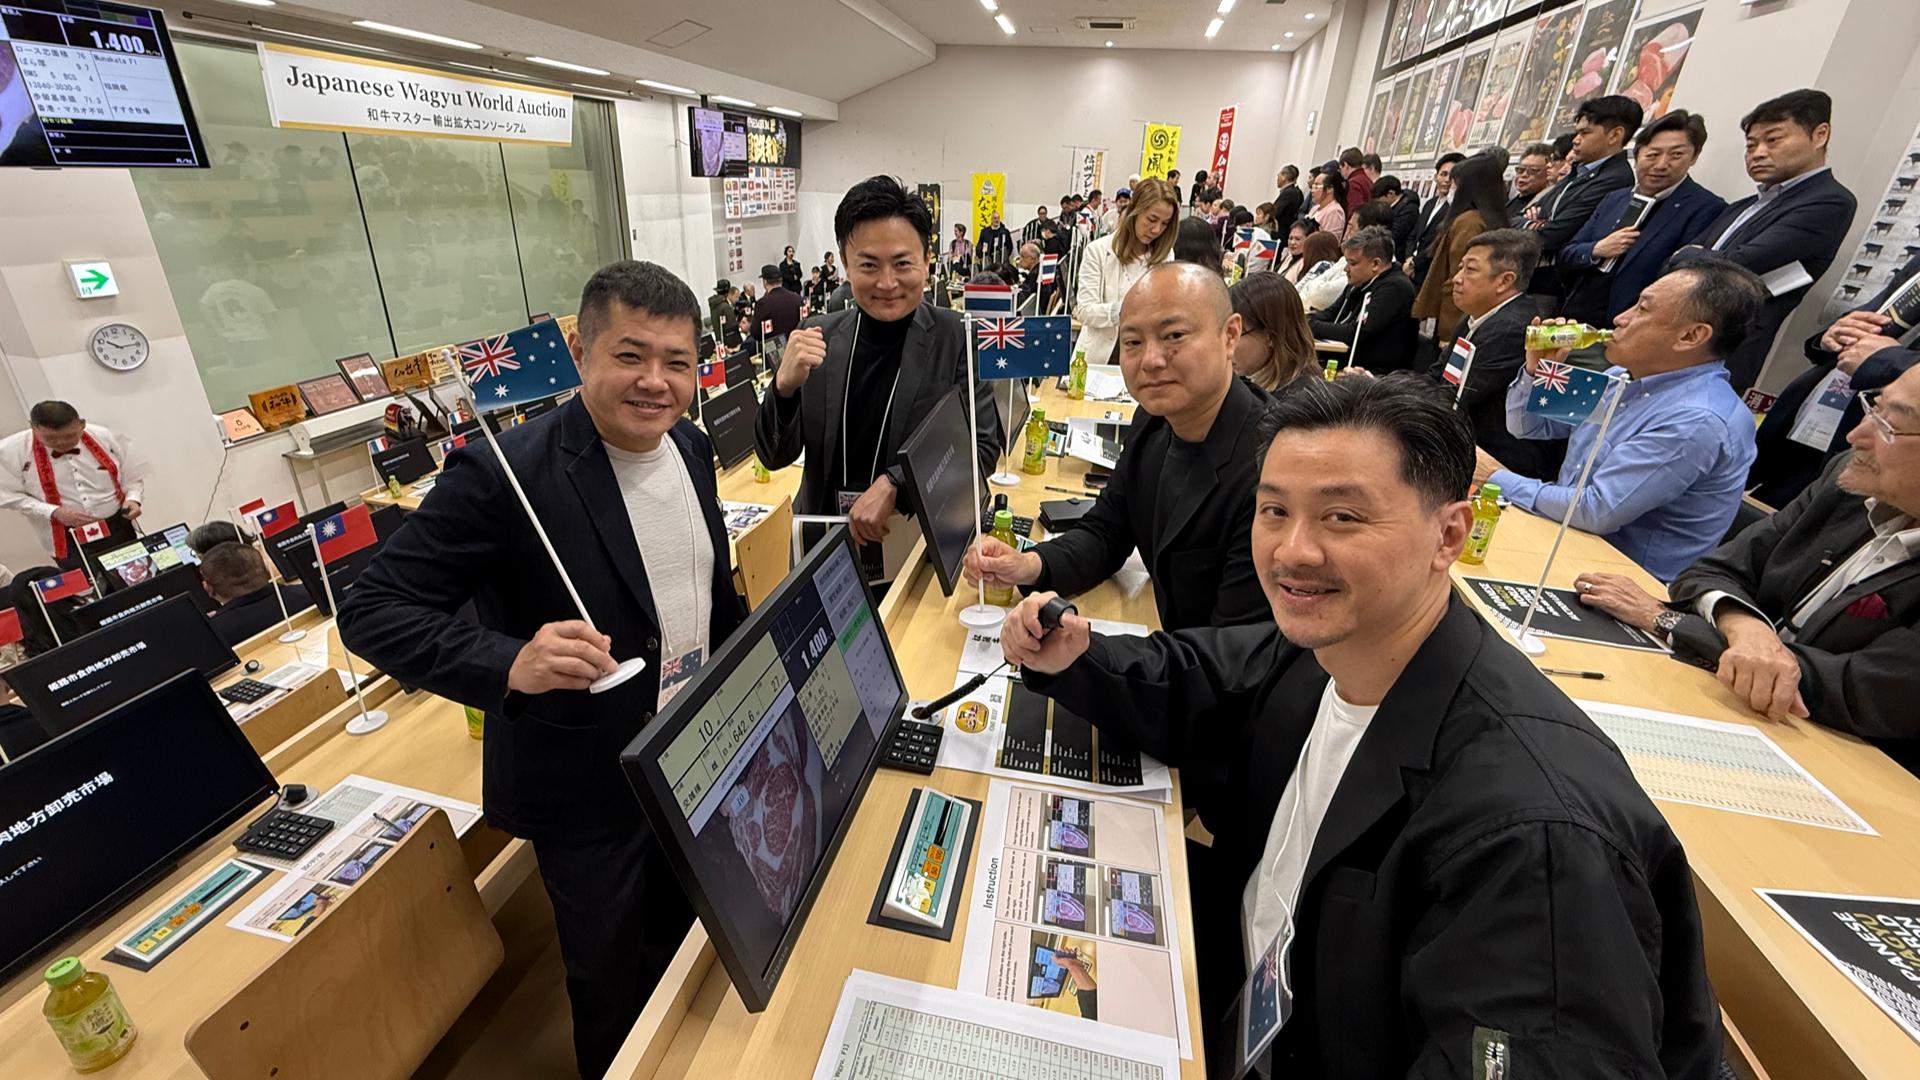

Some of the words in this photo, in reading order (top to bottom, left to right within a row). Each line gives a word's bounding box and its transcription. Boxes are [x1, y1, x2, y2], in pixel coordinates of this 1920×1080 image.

[286, 65, 394, 98] Japanese
[400, 80, 462, 108] Wagyu
[466, 90, 513, 112] World
[517, 98, 566, 118] Auction
[367, 107, 526, 134] 和牛マスター輸出拡大コンソーシアム
[47, 640, 146, 692] 姫路市食肉地方卸売市場
[771, 676, 780, 693] 27
[697, 719, 714, 743] 10
[984, 857, 998, 908] Instruction
[1832, 911, 1920, 989] PANESE
